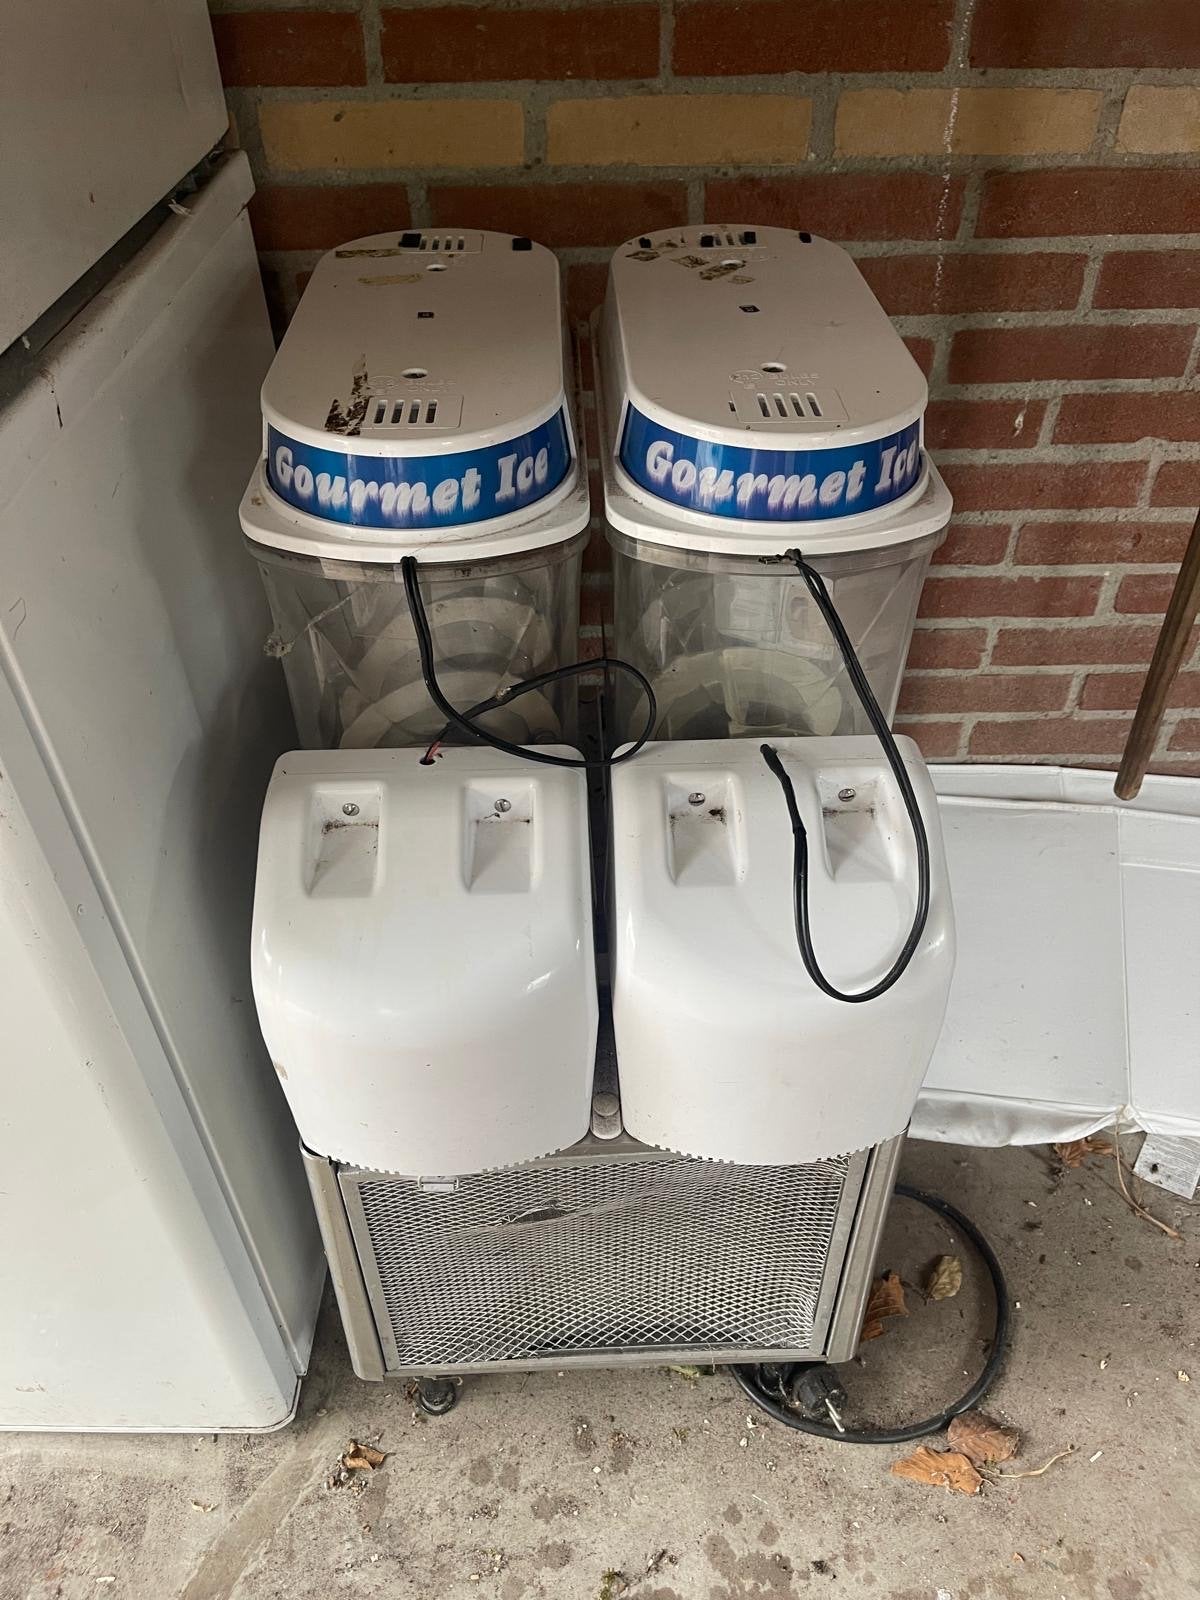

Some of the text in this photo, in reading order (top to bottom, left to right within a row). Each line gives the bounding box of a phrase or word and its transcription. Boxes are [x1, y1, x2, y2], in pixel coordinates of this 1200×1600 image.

[274, 446, 549, 516] Gourmet Ice
[645, 440, 867, 510] Gourmet
